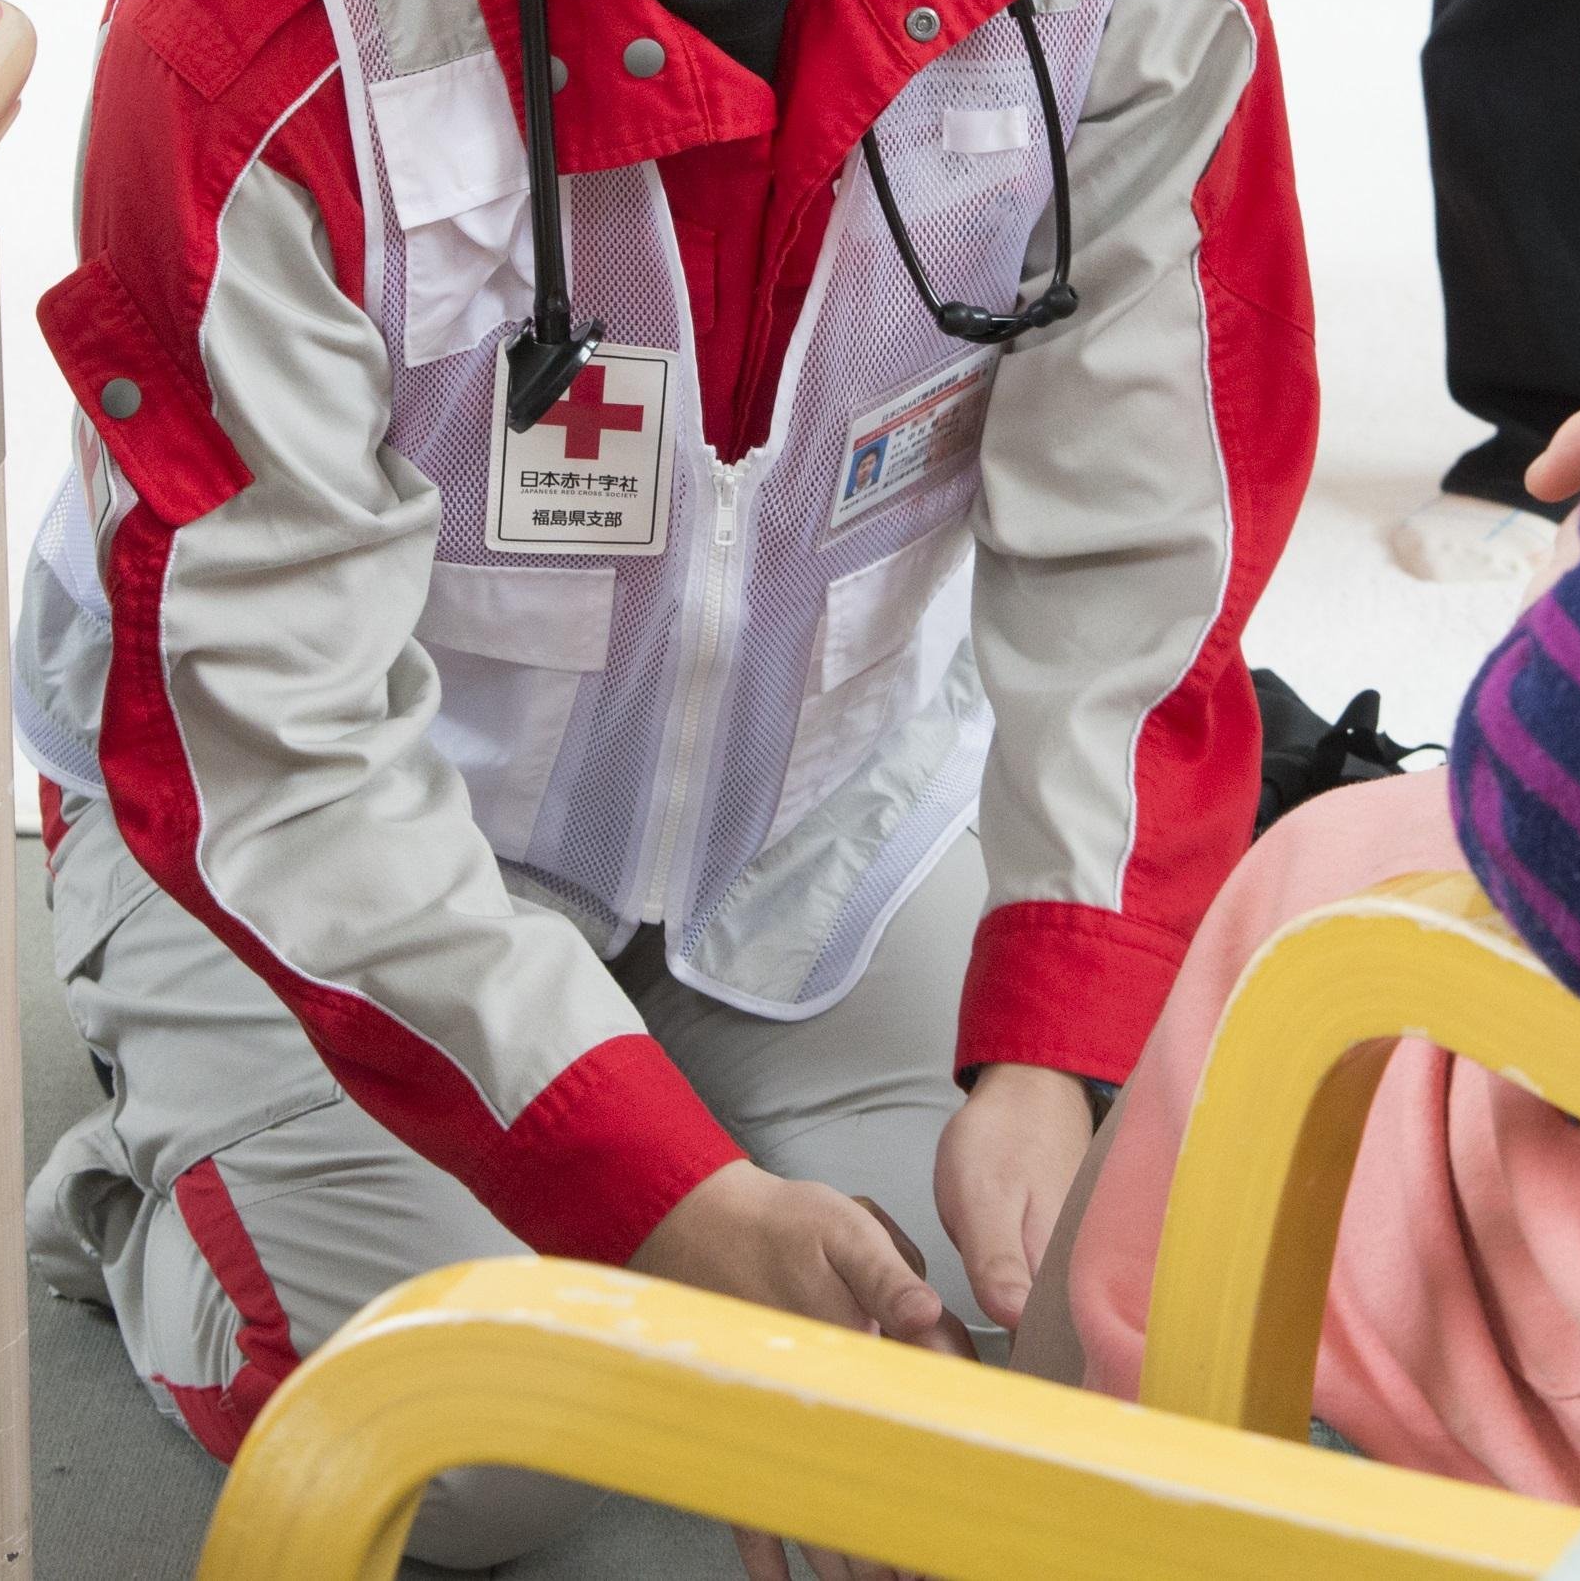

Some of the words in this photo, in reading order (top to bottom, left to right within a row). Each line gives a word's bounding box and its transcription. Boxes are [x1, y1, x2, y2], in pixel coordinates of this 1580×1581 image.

[520, 470, 639, 493] 日本赤十字社
[605, 491, 639, 499] SOCIETY
[531, 508, 623, 528] 福島県支部
